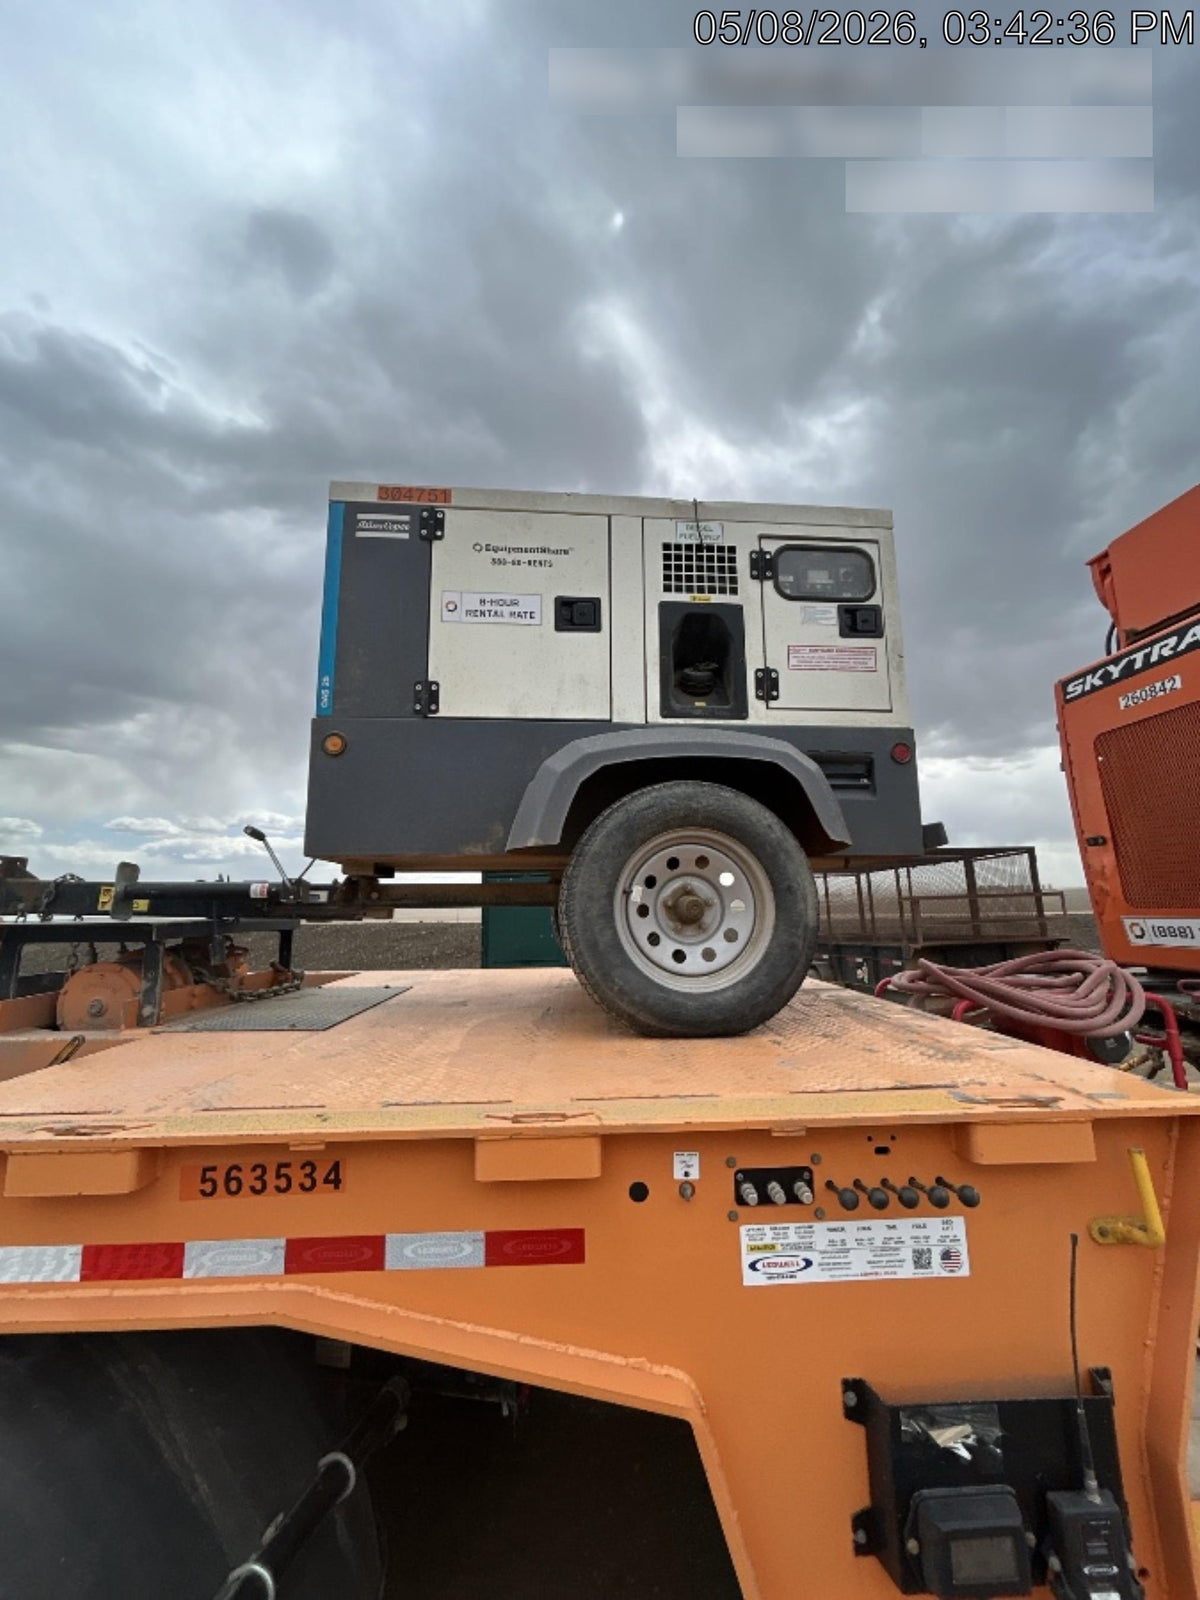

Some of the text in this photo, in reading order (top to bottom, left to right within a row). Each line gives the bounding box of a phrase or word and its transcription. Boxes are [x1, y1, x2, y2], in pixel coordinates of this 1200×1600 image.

[378, 486, 448, 504] 304751
[465, 609, 506, 619] RENTAL
[1121, 676, 1178, 709] 260842
[198, 1160, 344, 1198] 563534
